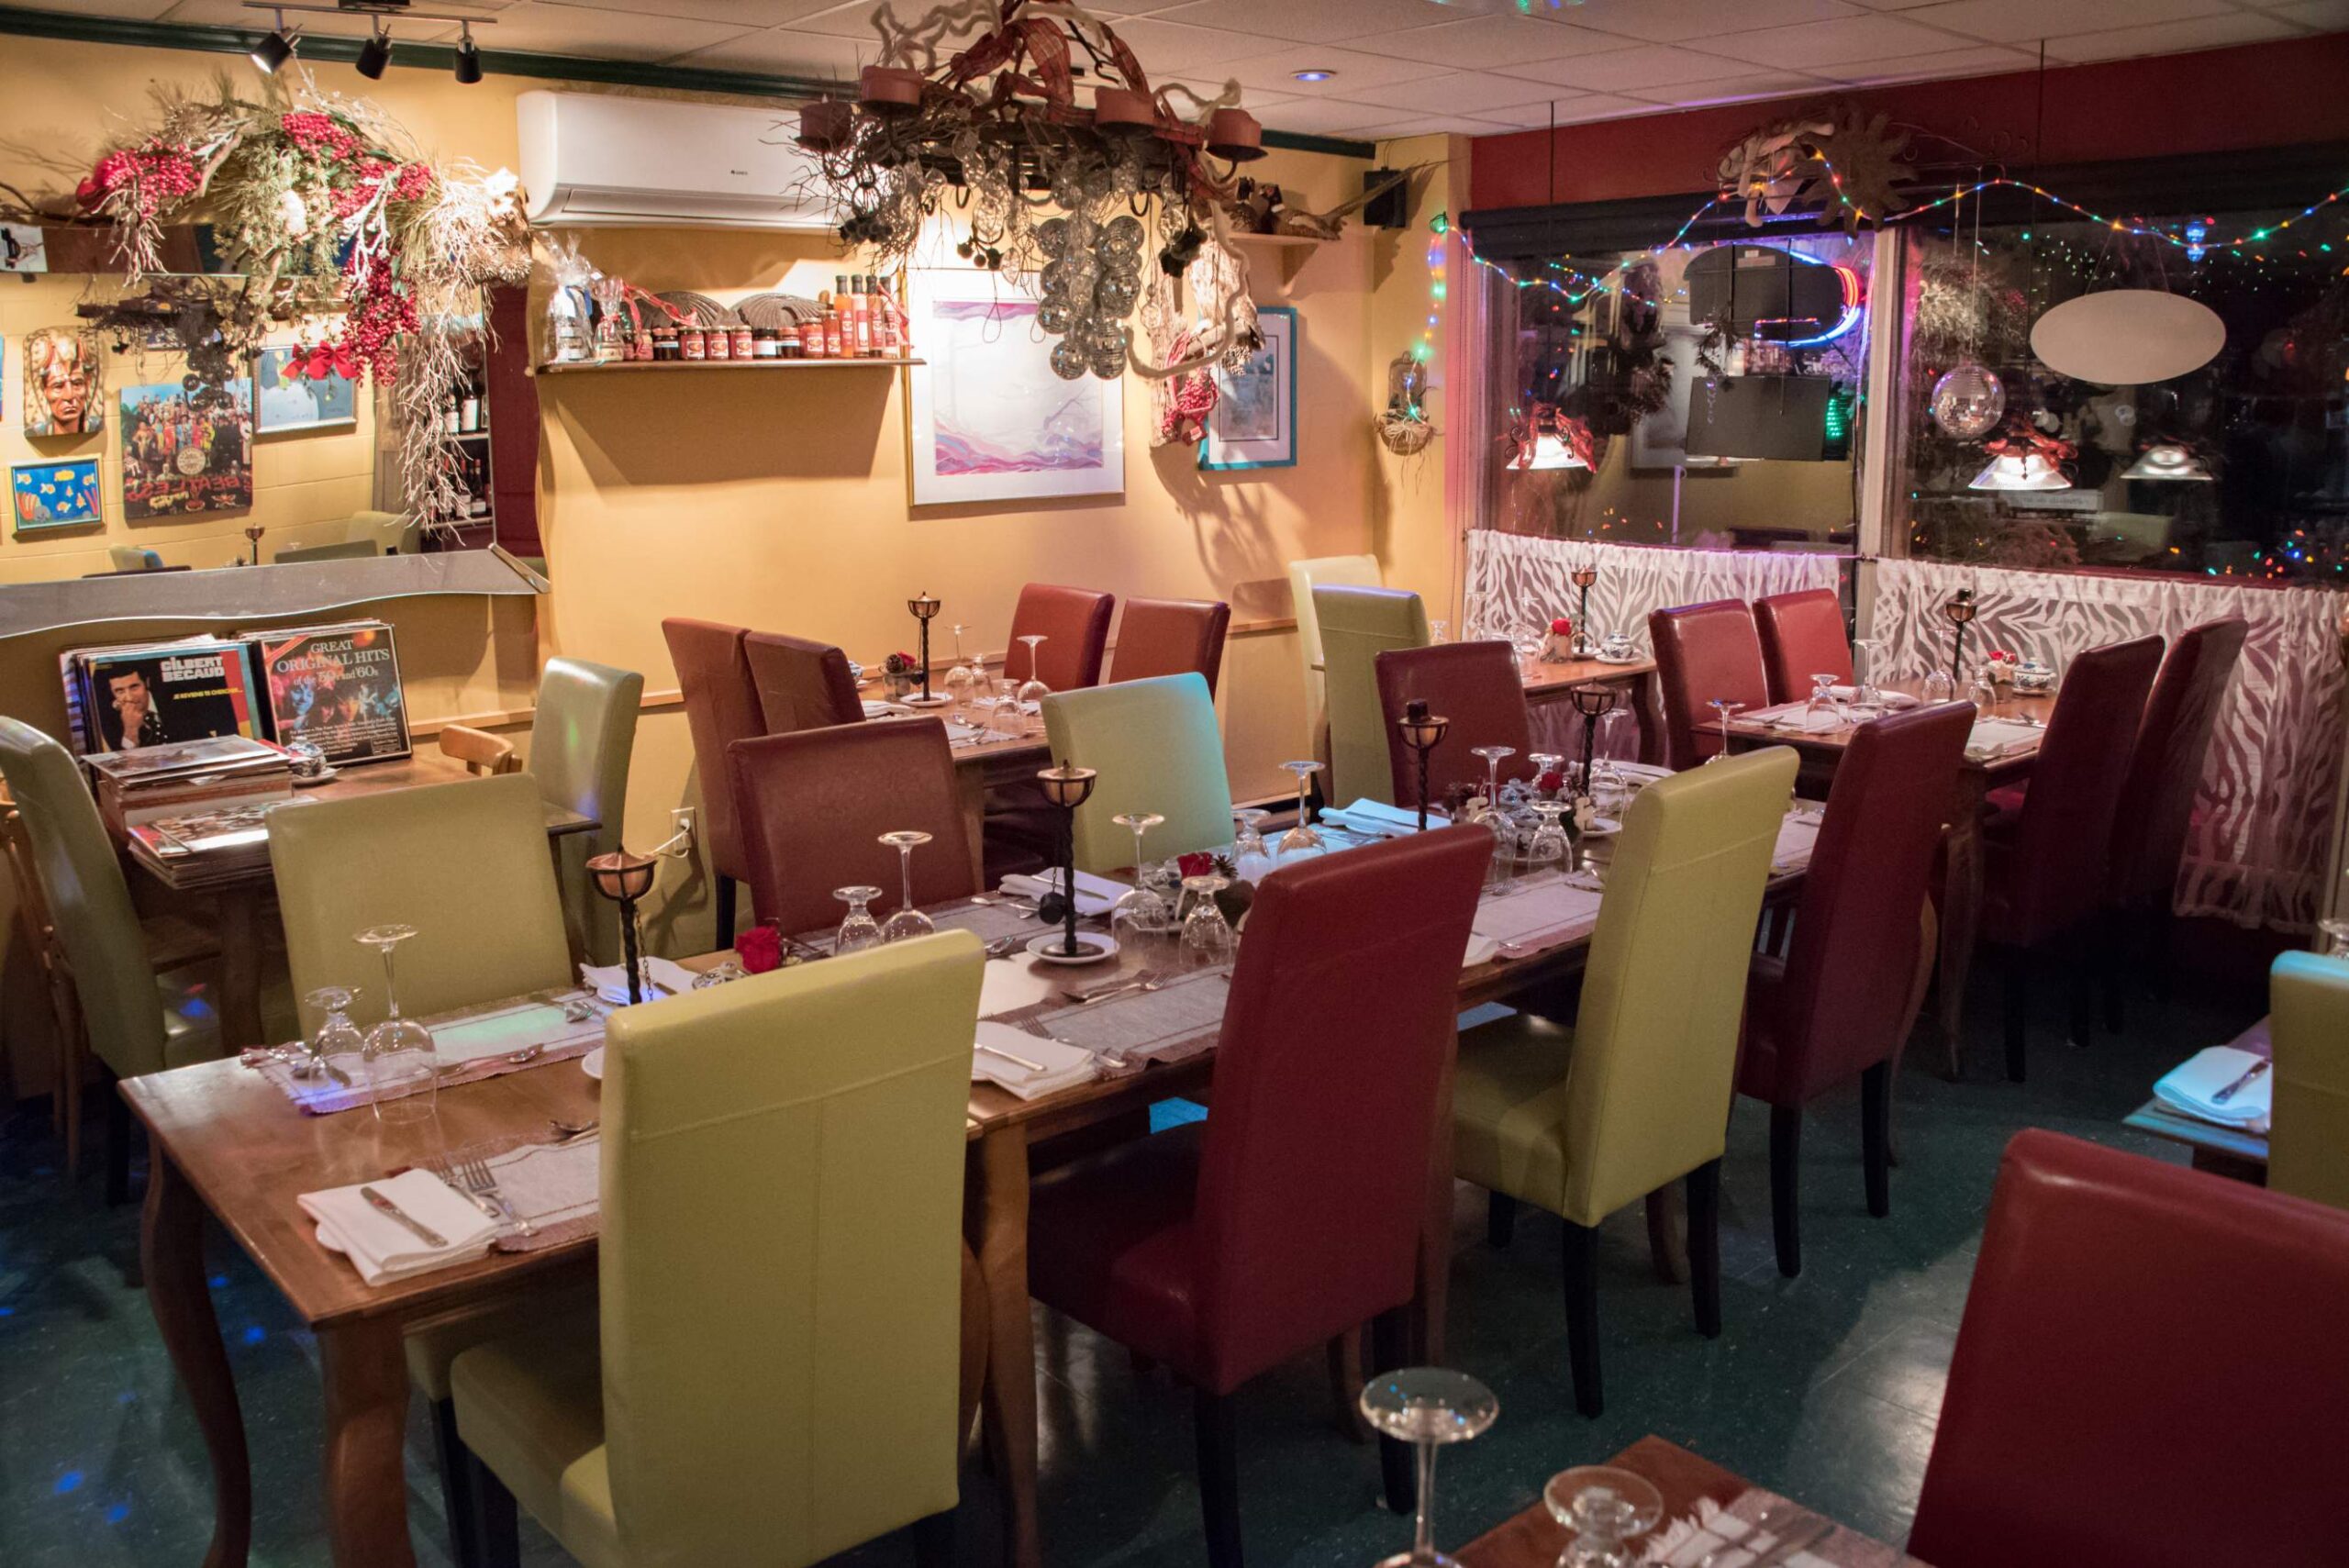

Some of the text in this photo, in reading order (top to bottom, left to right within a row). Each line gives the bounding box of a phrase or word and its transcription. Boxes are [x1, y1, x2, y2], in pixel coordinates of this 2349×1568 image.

[310, 639, 354, 653] GREAT
[276, 648, 390, 673] ORIGINAL HITS
[161, 667, 226, 682] BECAUD
[304, 675, 316, 684] the
[340, 671, 356, 680] and
[355, 665, 379, 678] '60s
